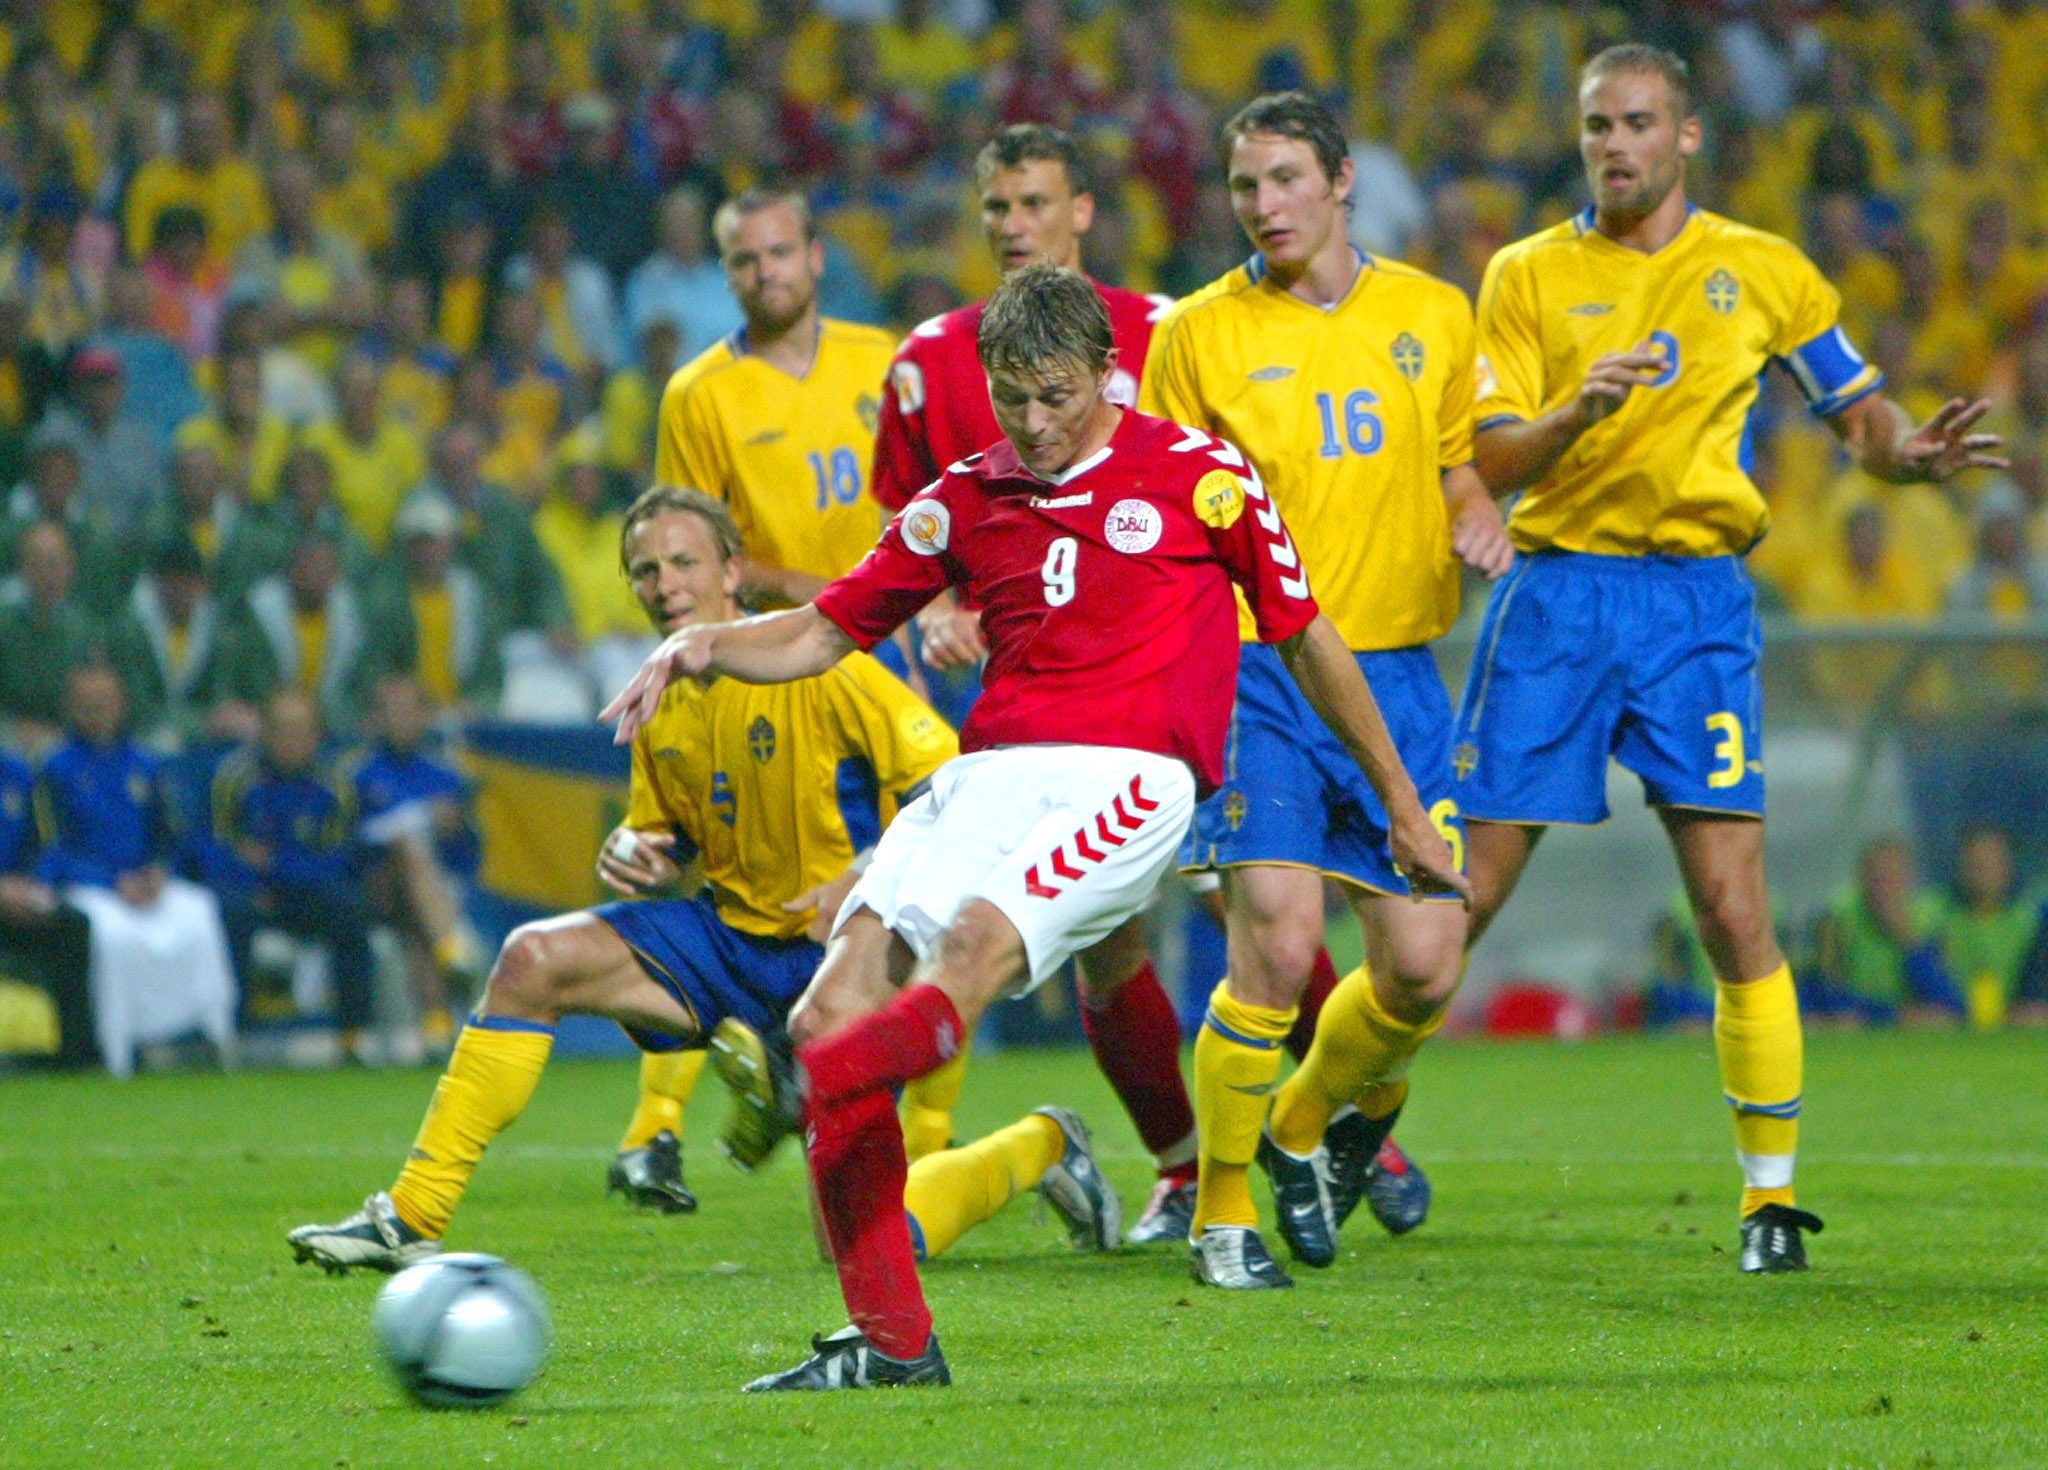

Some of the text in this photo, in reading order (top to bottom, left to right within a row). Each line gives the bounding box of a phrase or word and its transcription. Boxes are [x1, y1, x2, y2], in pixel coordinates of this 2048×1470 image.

[1315, 389, 1384, 458] 16
[806, 446, 861, 511] 18
[1117, 516, 1149, 532] DBU
[1041, 536, 1079, 607] 9
[1705, 711, 1745, 789] 3
